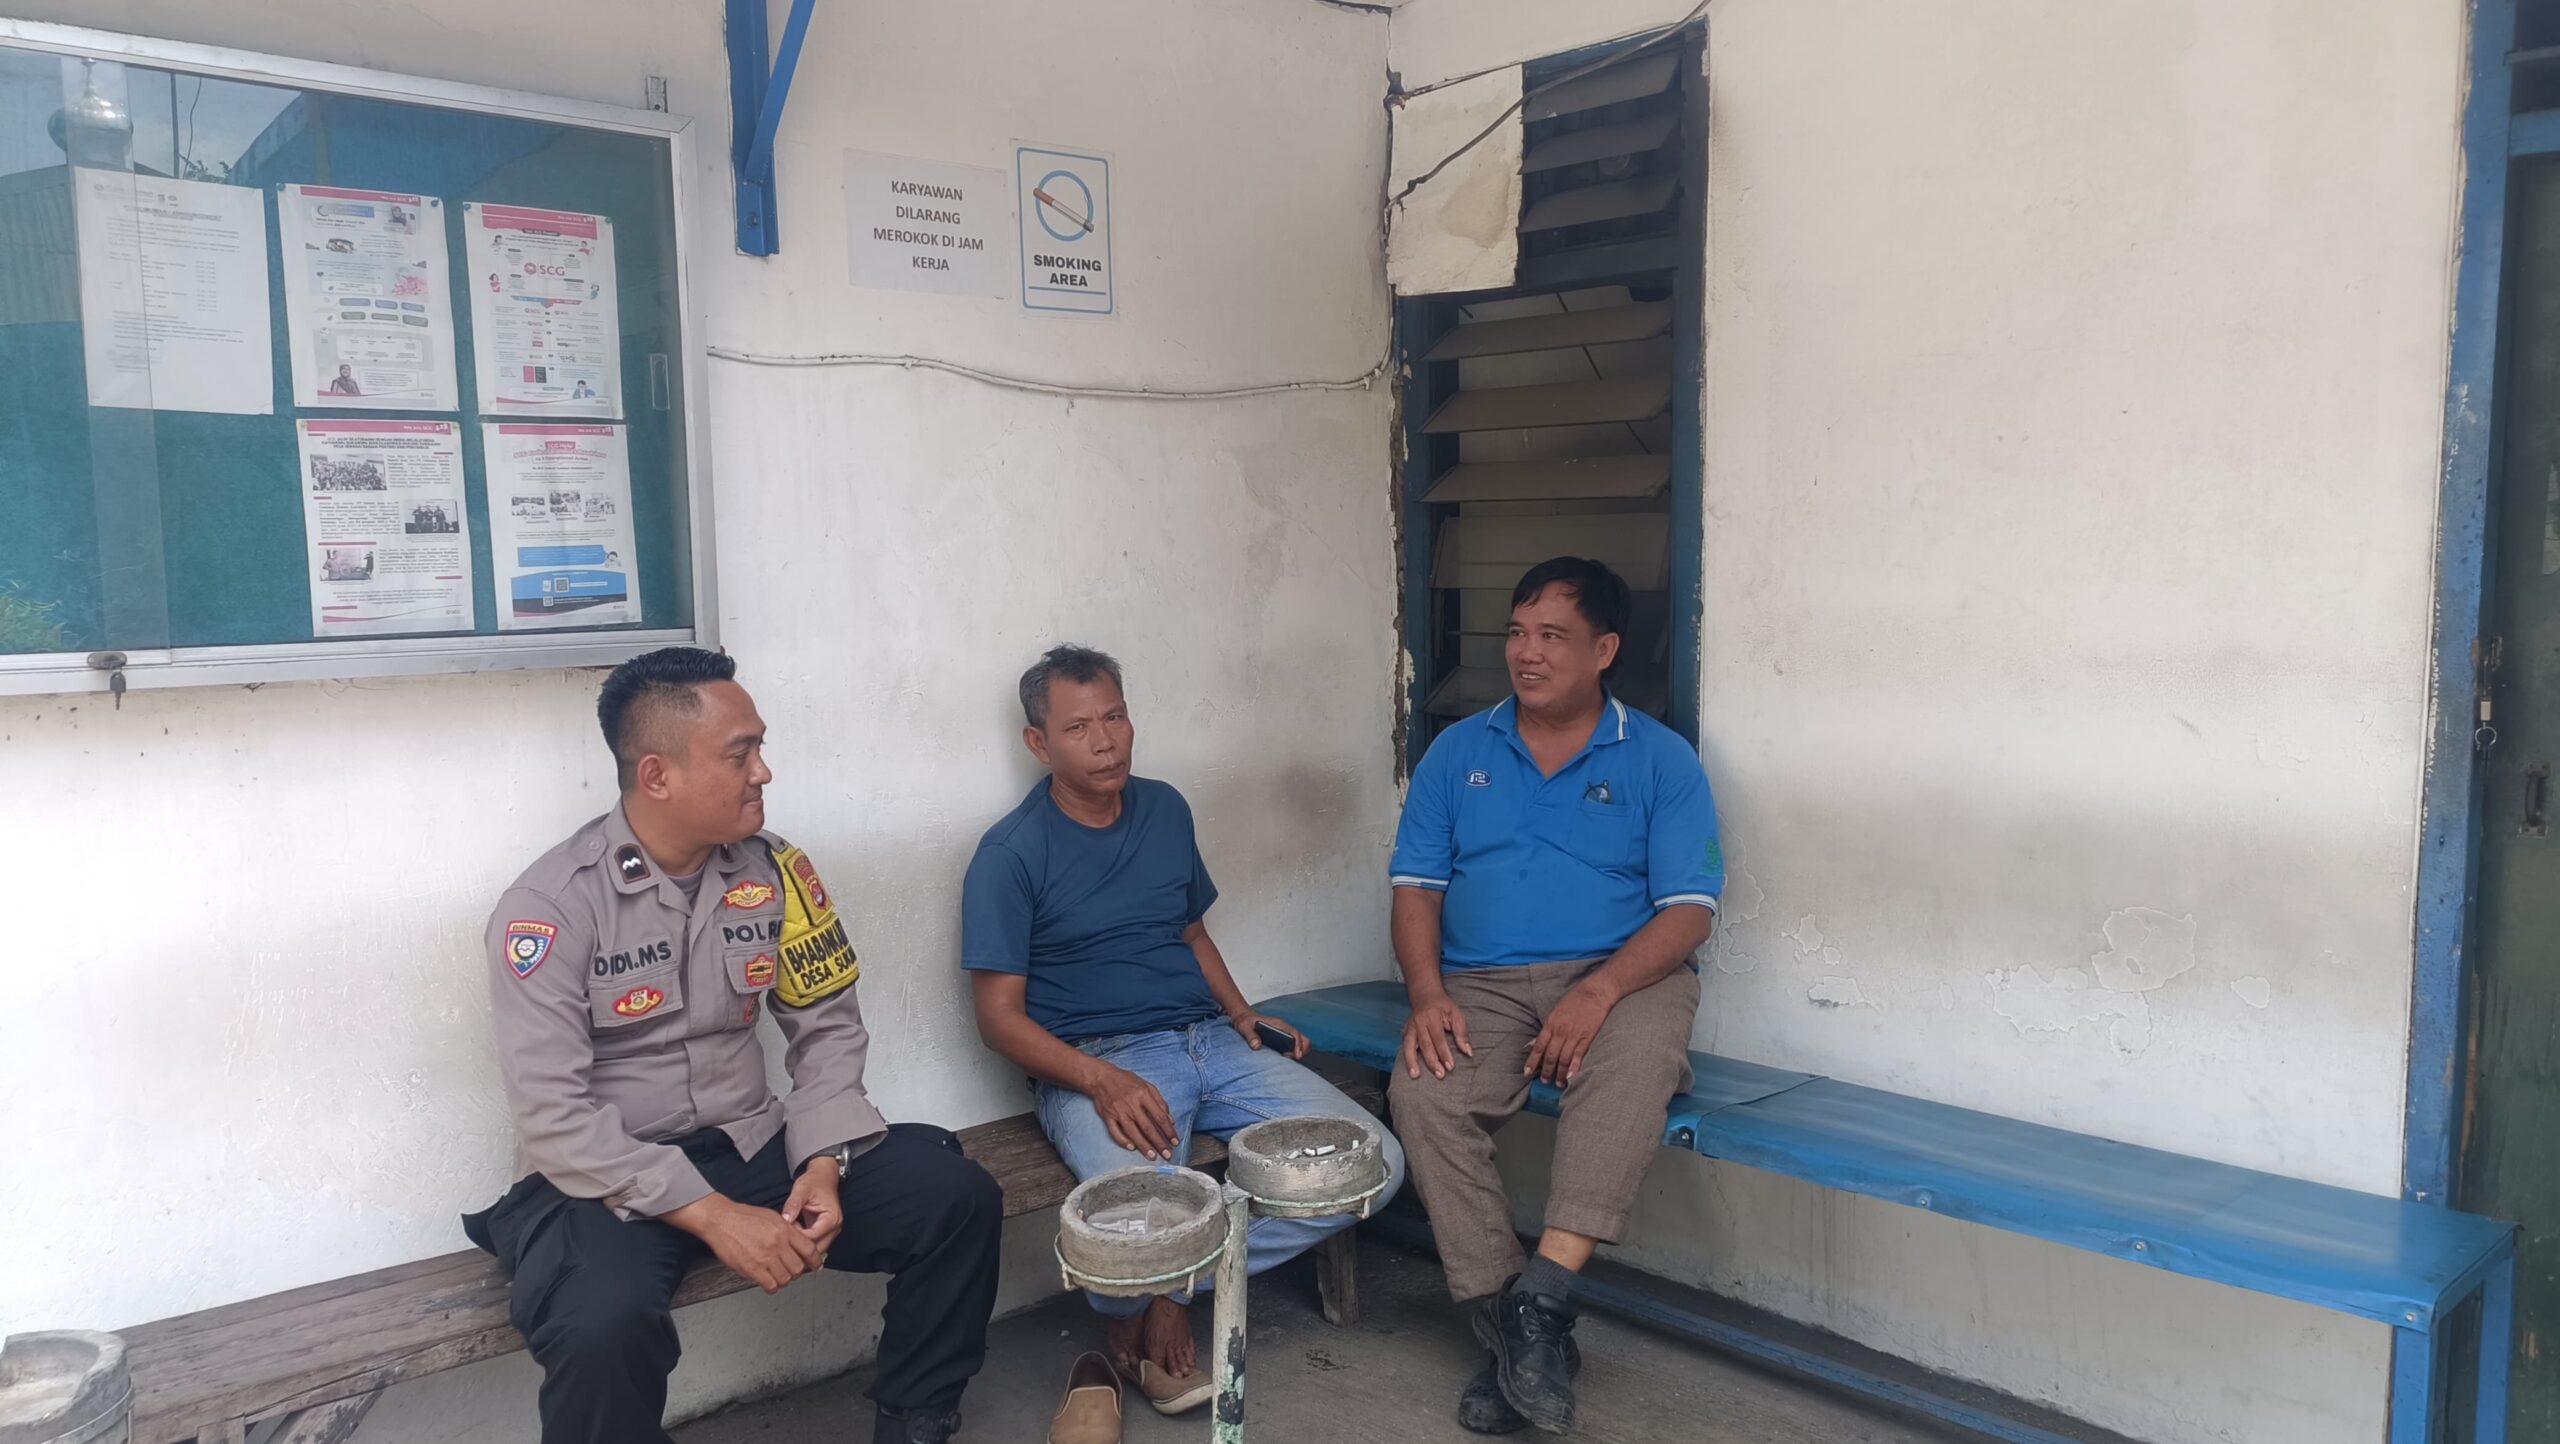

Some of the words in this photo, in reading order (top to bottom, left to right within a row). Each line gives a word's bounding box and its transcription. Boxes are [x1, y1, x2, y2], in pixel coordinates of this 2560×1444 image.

[891, 180, 963, 201] KARYAWAN
[896, 205, 961, 224] DILARANG
[873, 227, 939, 246] MEROKOK
[942, 235, 954, 248] DI
[958, 237, 984, 251] JAM
[539, 264, 565, 276] SCG
[912, 256, 950, 271] KERJA
[1033, 254, 1102, 272] SMOKING
[1050, 272, 1088, 287] AREA
[512, 924, 550, 934] BINMAS
[594, 940, 672, 976] DIDI.MS
[800, 962, 834, 990] DESA
